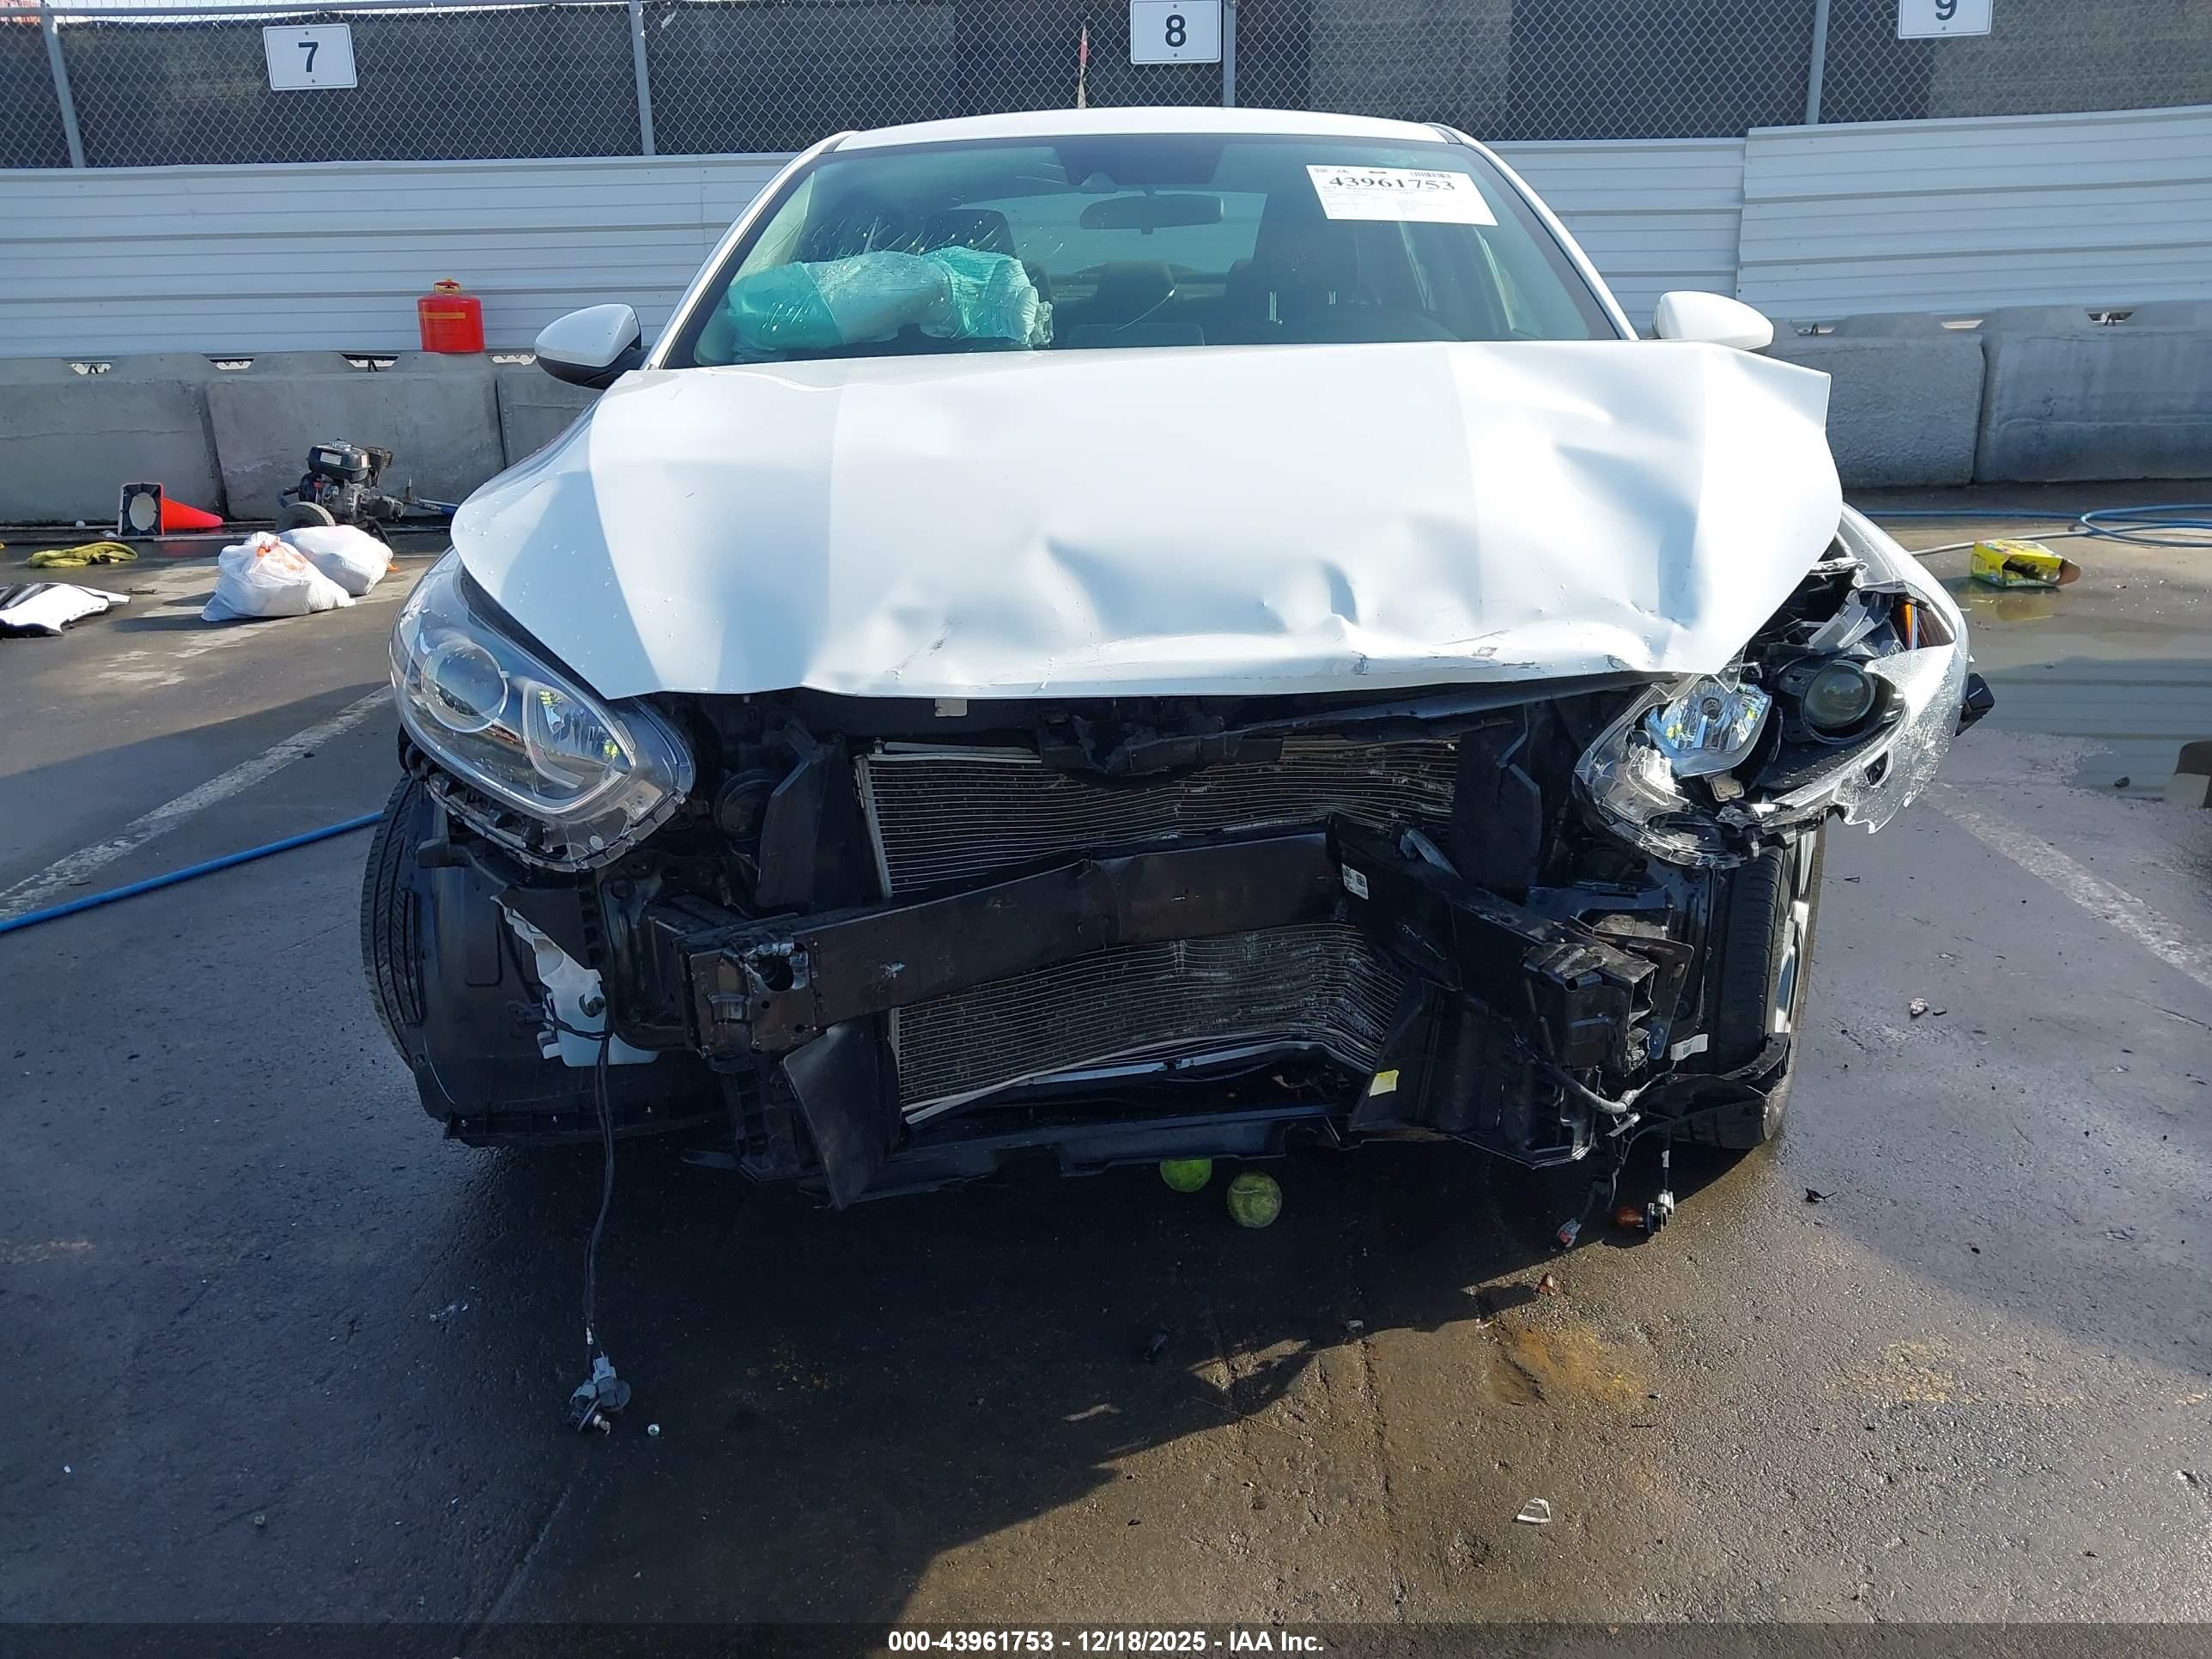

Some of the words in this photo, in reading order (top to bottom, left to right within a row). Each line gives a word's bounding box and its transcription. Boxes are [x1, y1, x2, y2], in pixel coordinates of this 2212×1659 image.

[1935, 0, 1958, 21] 9
[1165, 15, 1187, 47] 8
[297, 41, 319, 73] 7
[1328, 177, 1455, 191] 43961753
